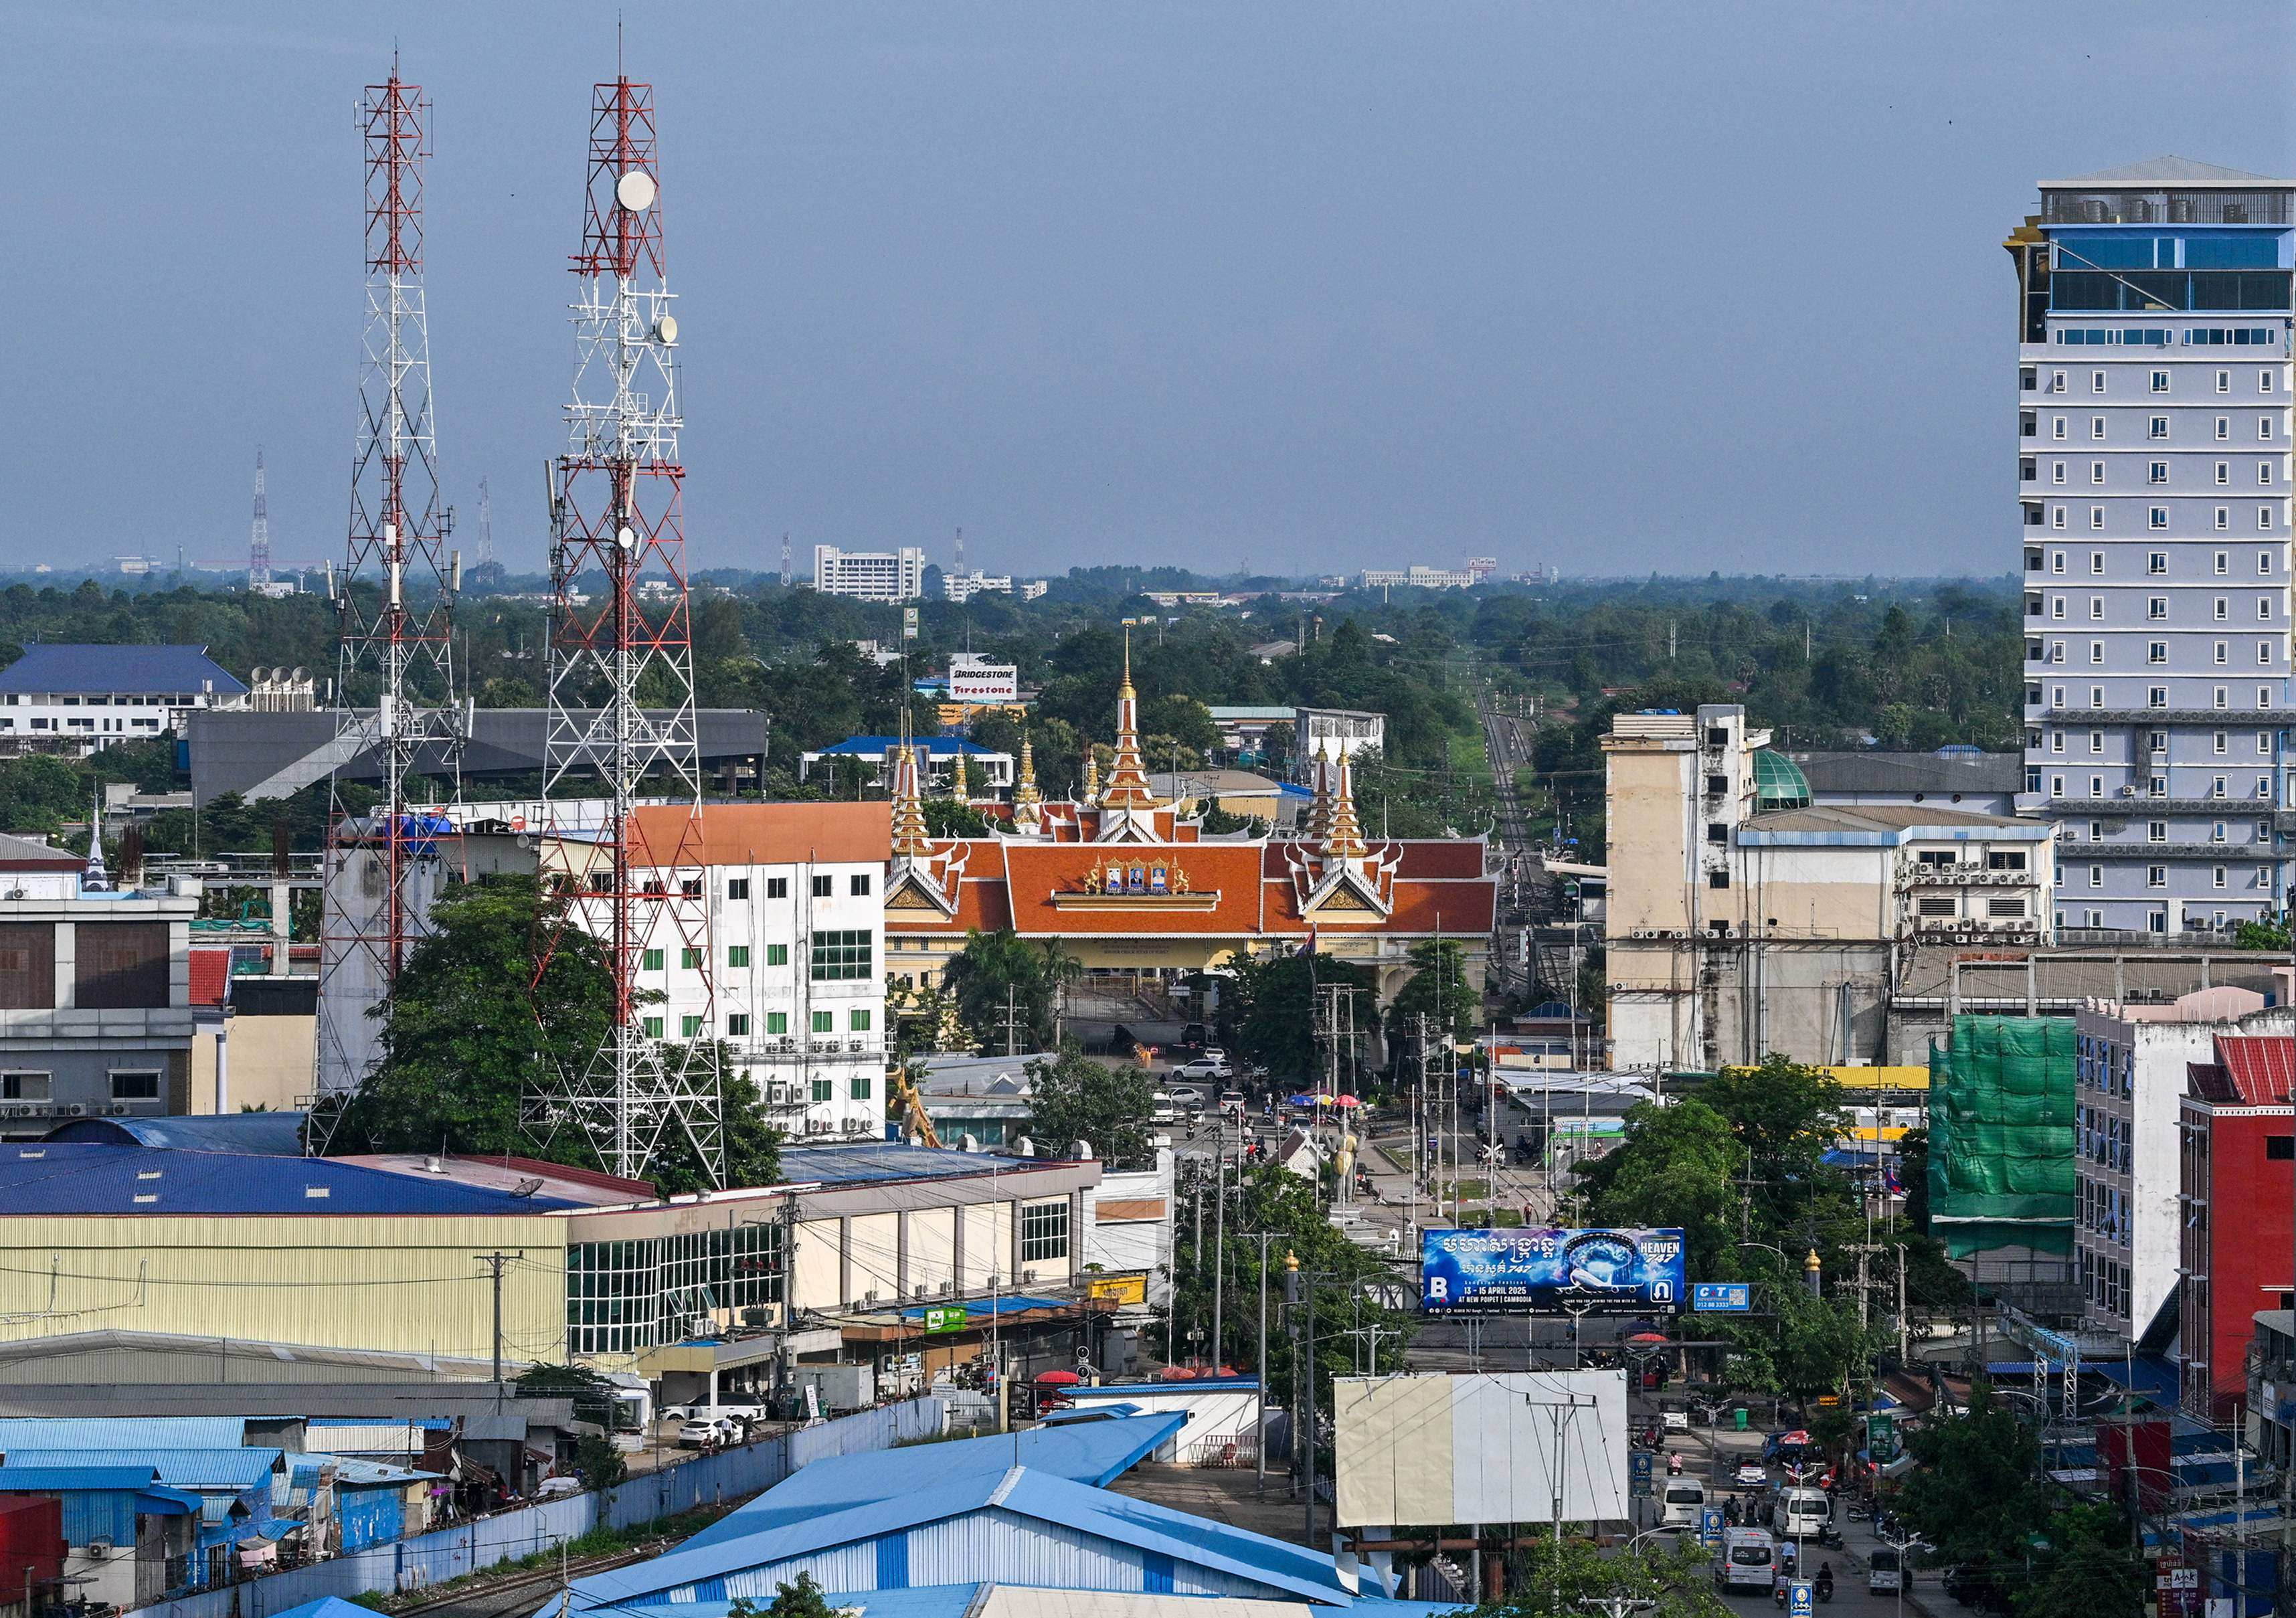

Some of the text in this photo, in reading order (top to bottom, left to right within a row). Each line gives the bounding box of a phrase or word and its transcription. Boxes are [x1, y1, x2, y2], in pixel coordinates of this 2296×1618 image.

[954, 670, 1014, 679] BRIDGESTONE
[954, 685, 1012, 695] Firestone
[1640, 1242, 1680, 1253] HEAVEN
[1646, 1253, 1676, 1263] 747
[1507, 1265, 1532, 1273] 747
[1431, 1277, 1447, 1297] B
[1464, 1287, 1472, 1295] 13
[1479, 1287, 1486, 1295] 15
[1488, 1287, 1507, 1295] APRIL
[1508, 1287, 1527, 1295] 2025
